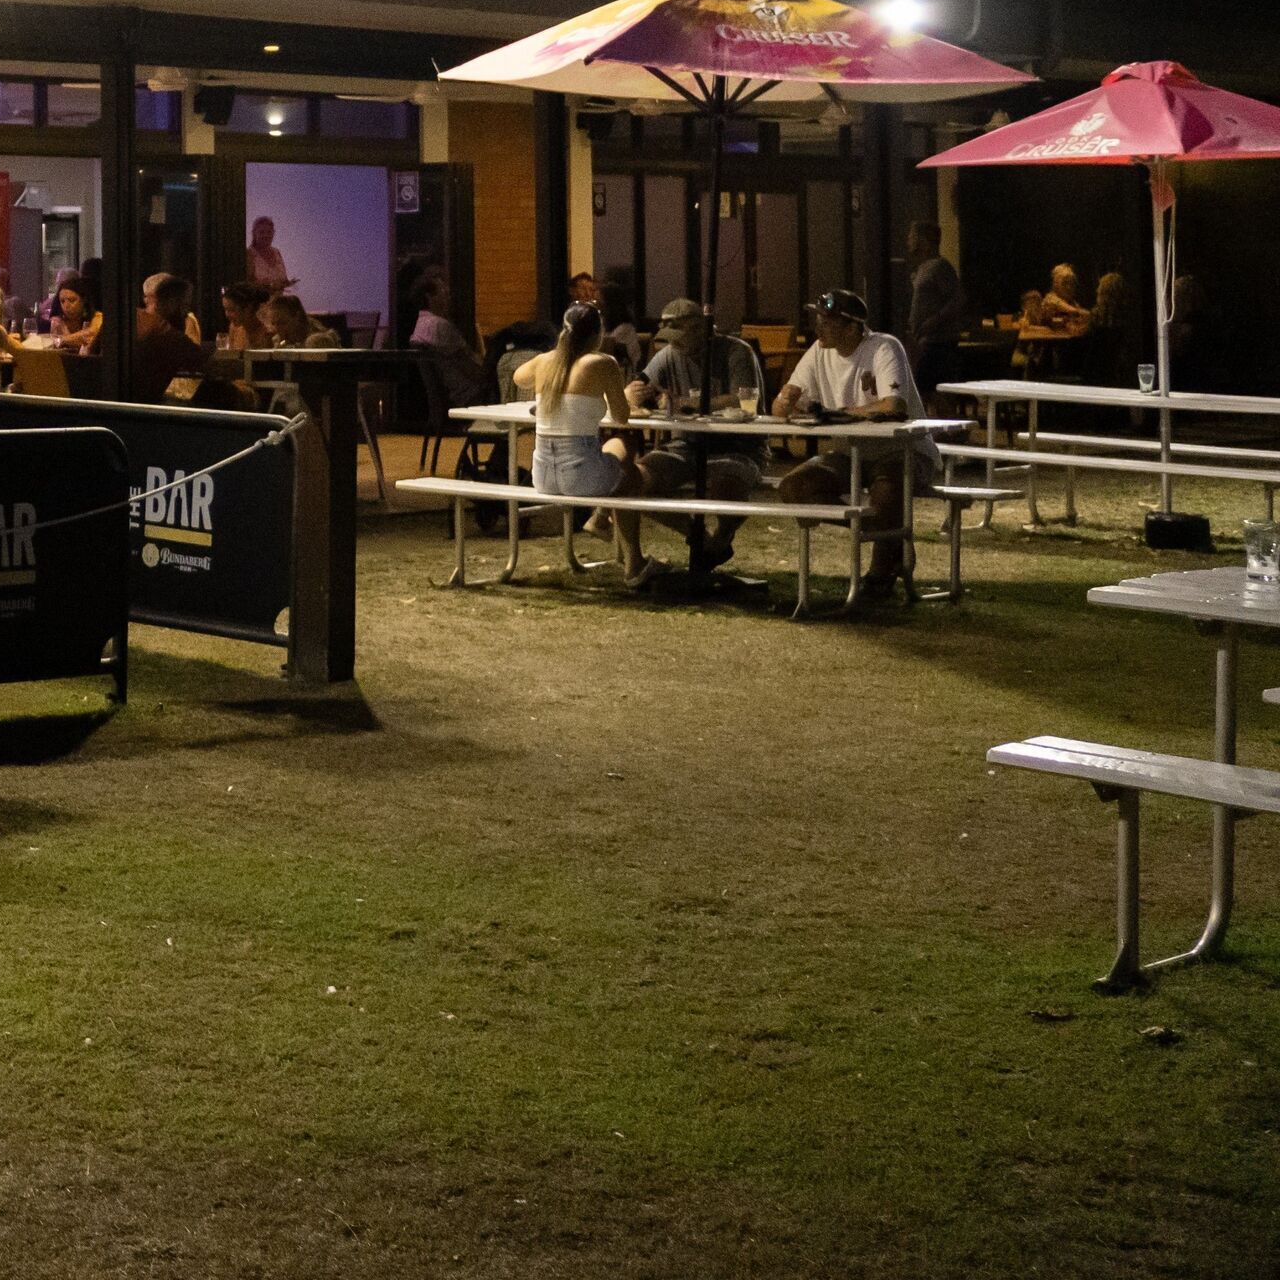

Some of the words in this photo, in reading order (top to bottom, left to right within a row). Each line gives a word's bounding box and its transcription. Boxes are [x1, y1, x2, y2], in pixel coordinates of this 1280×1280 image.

[715, 24, 860, 48] CRUISER
[1005, 138, 1121, 160] CRUISER
[129, 485, 141, 531] THE
[144, 465, 214, 530] BAR
[160, 547, 211, 571] BUNDABERG
